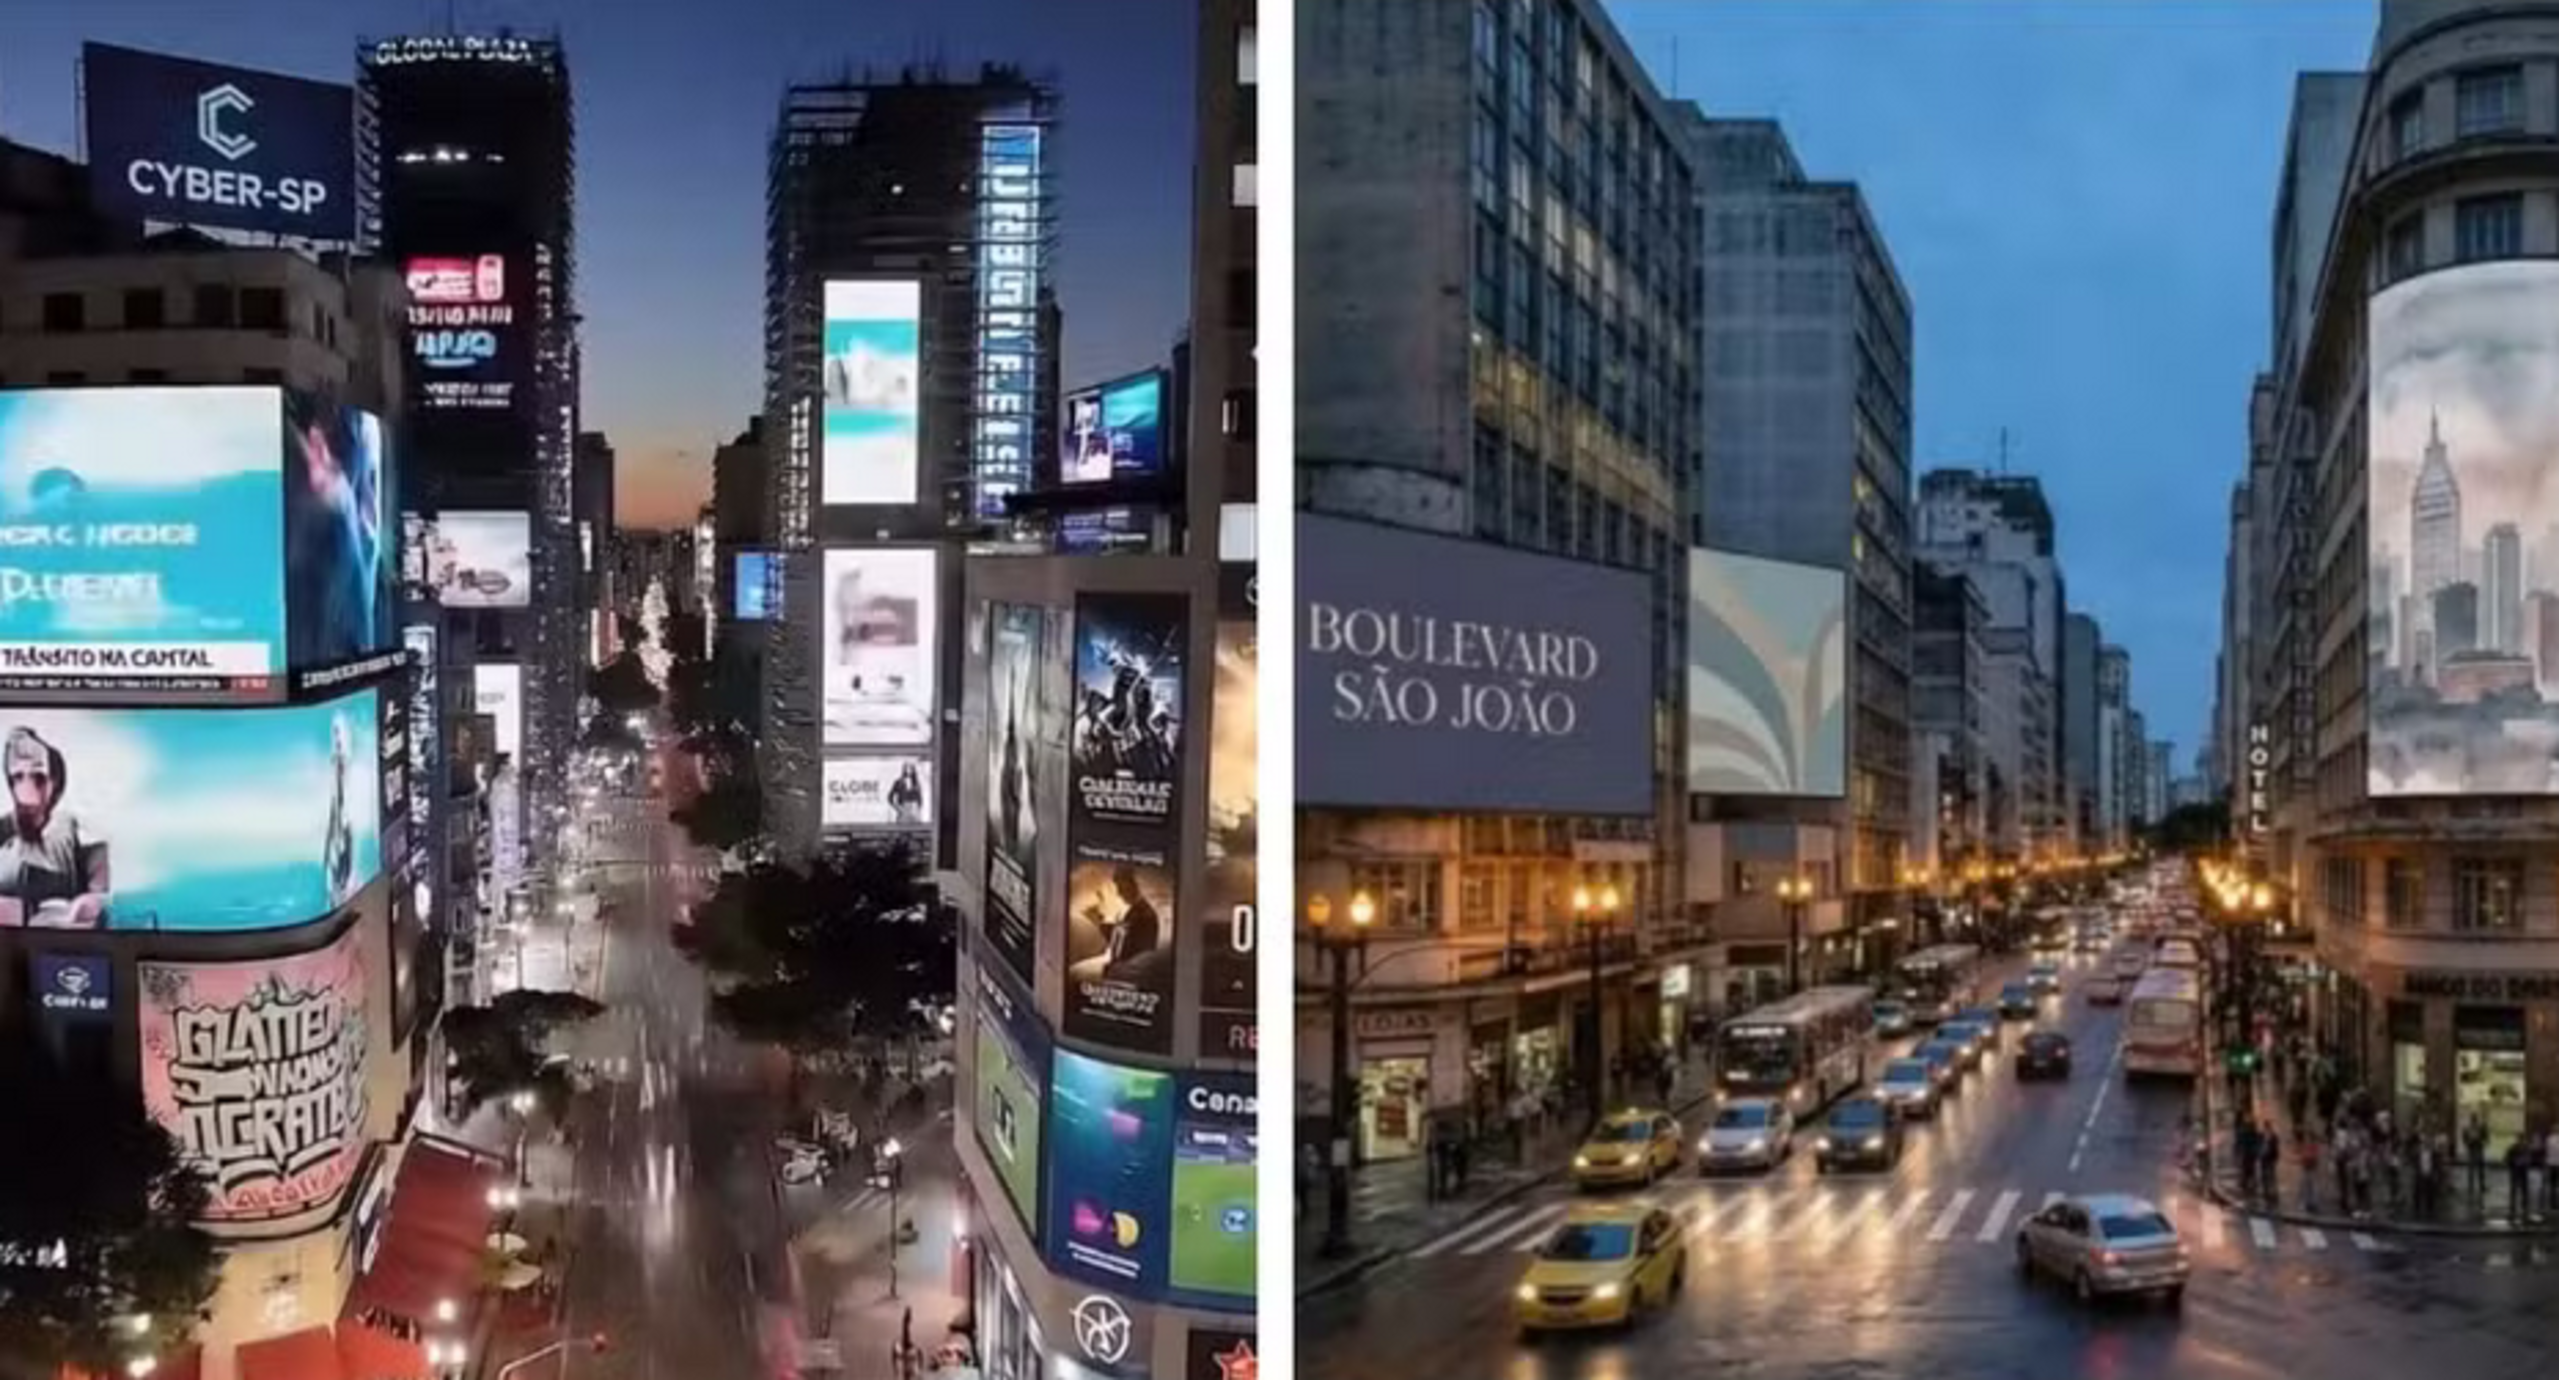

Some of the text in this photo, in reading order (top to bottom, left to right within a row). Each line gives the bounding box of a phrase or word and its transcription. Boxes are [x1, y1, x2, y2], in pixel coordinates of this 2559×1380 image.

[127, 158, 327, 214] CYBER-SP
[1309, 603, 1598, 681] BOULEVARD
[1332, 663, 1577, 735] SÃO JOÃO
[2250, 724, 2269, 832] HOTEL
